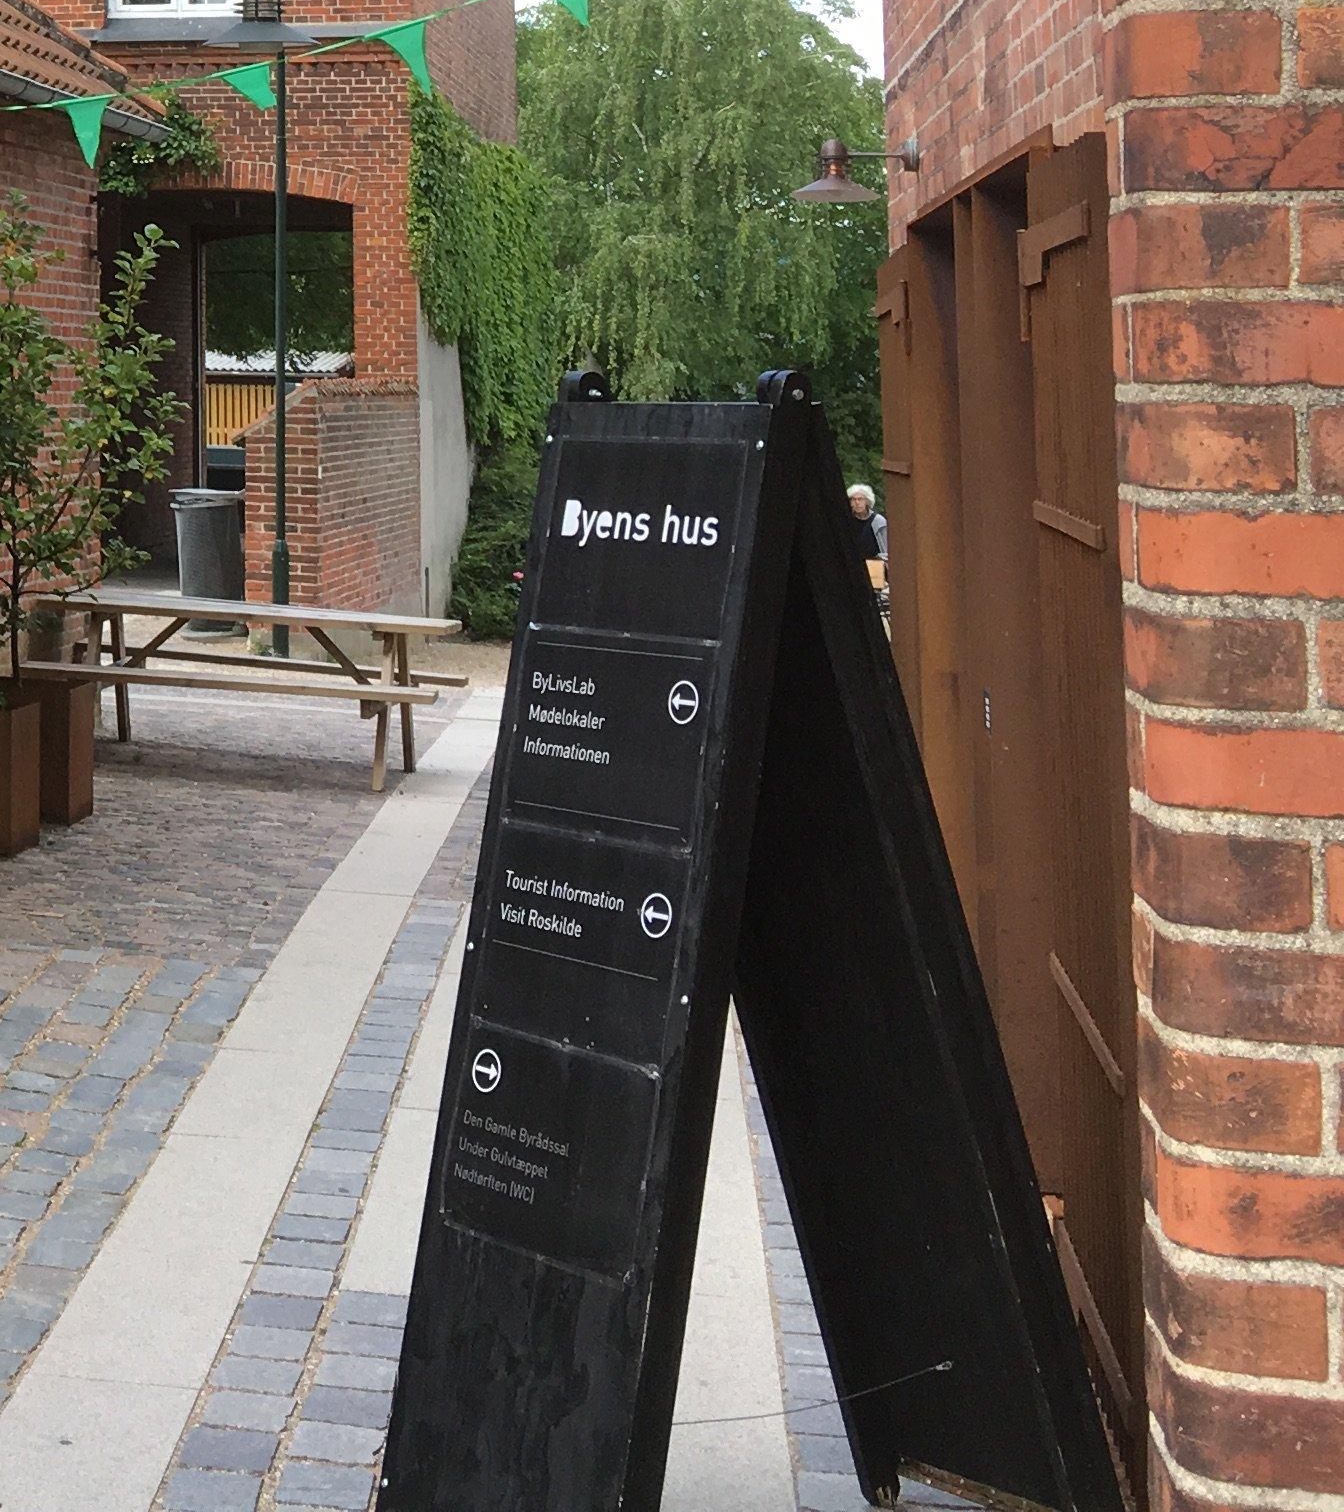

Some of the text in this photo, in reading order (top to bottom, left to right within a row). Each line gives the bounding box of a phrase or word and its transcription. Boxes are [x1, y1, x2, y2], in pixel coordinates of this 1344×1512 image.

[561, 499, 718, 546] Byens hus
[532, 672, 595, 696] ByLivsLab
[528, 704, 605, 730] Mødelokaler
[523, 736, 610, 765] Informationen
[505, 869, 625, 912] Tourist Information
[500, 903, 582, 938] Visit Roskilde
[463, 1110, 569, 1157] Den Gamle Byrådssal
[459, 1137, 549, 1179] Under Gulvtæppet
